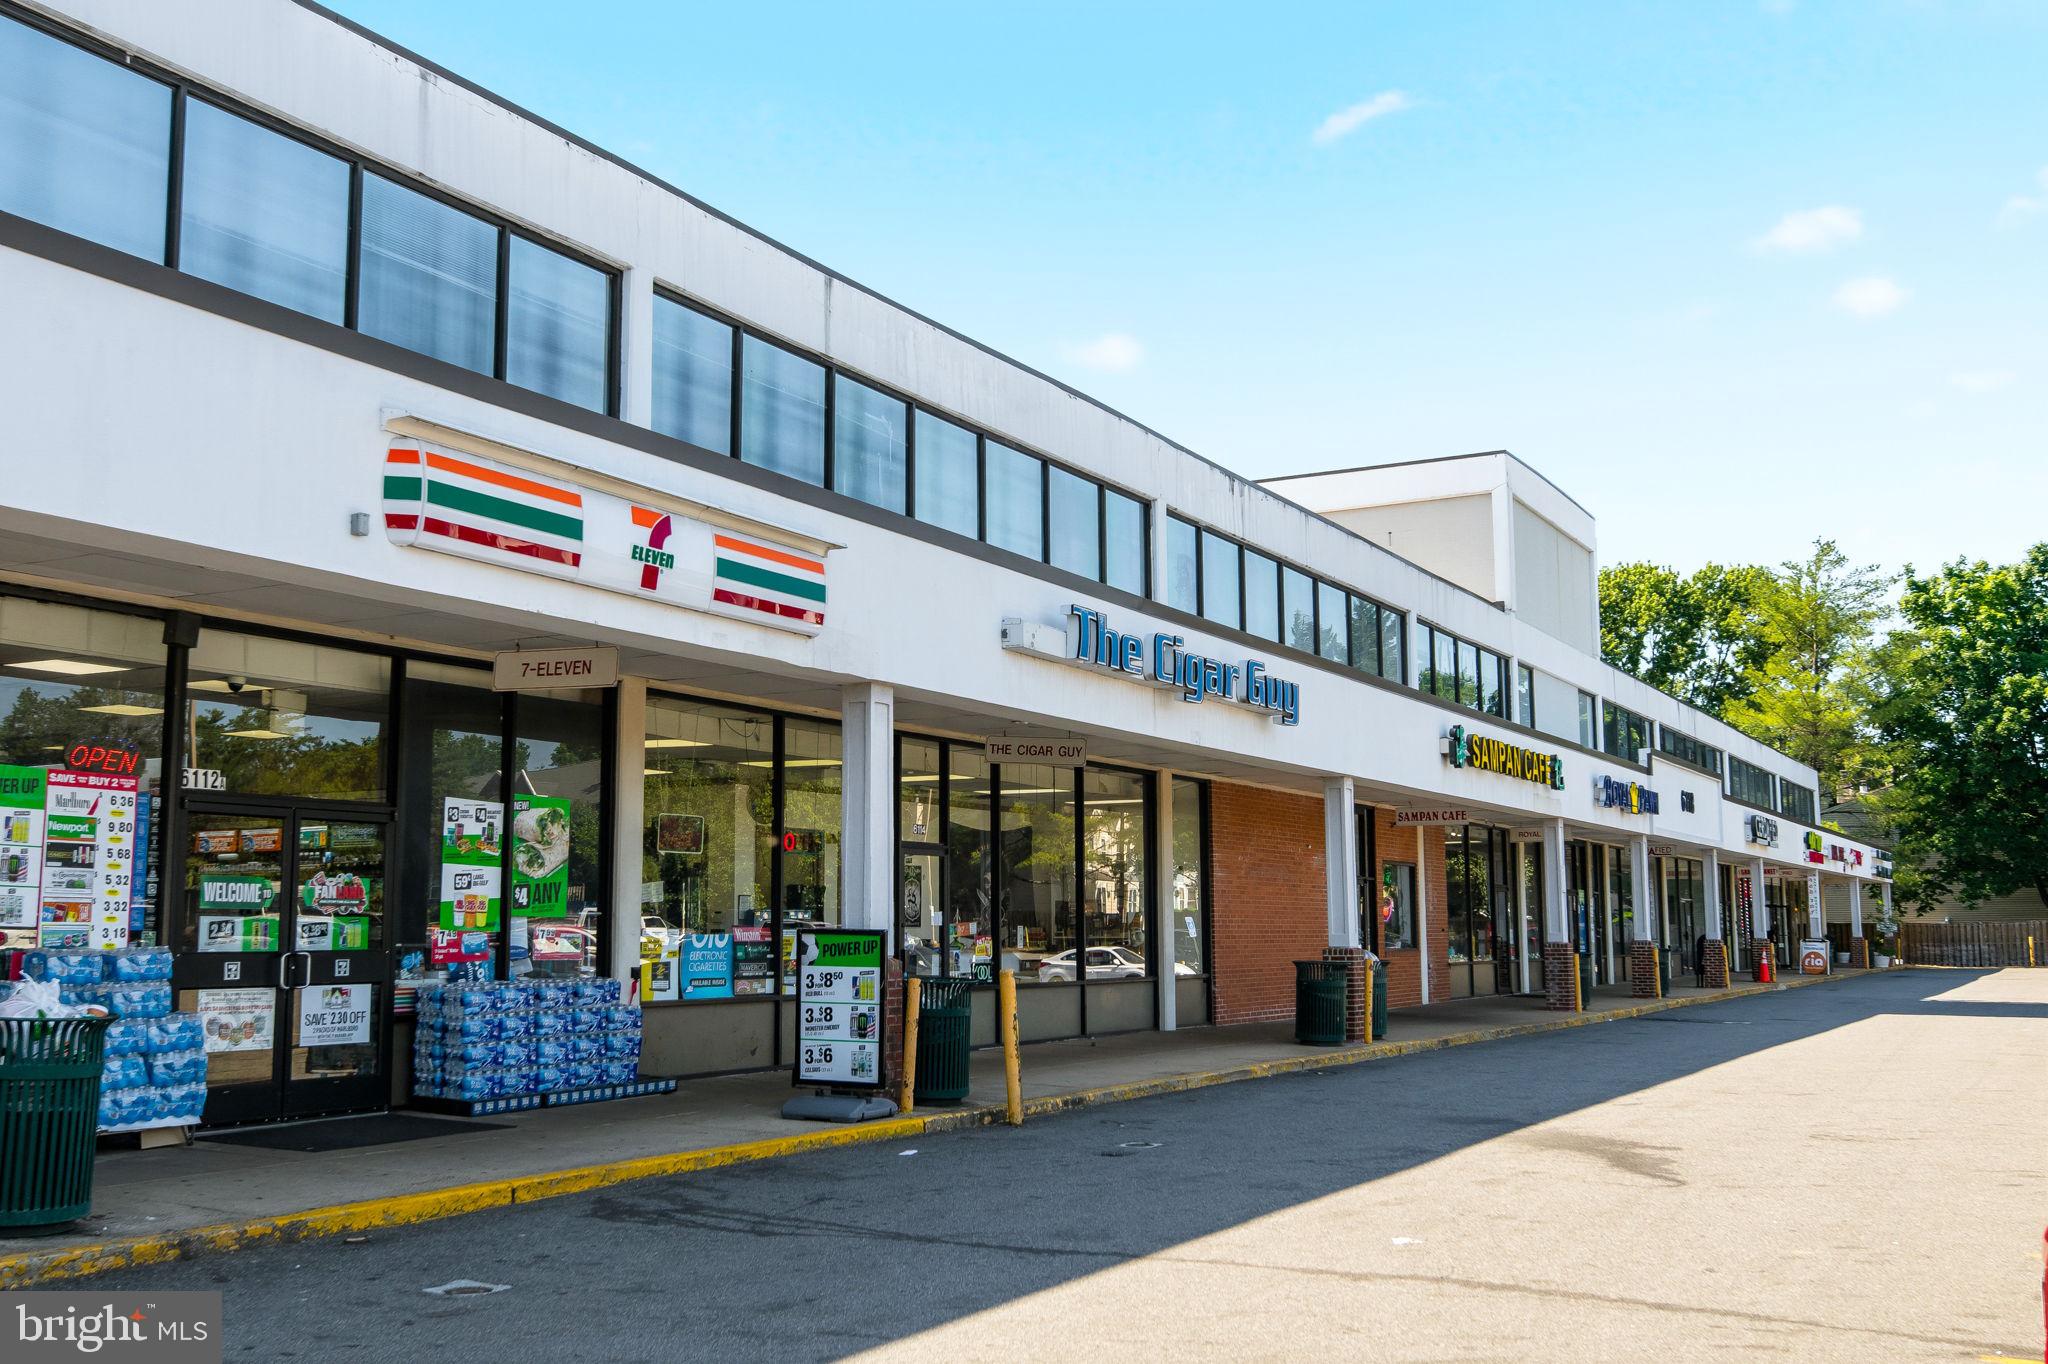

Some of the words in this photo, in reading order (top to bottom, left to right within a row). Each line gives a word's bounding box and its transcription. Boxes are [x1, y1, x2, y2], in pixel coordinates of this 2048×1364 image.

[631, 544, 674, 569] ELEVEN
[521, 660, 592, 677] 7-ELEVEN
[1071, 603, 1144, 675] The
[1153, 631, 1240, 704] Cigar
[1246, 658, 1300, 726] Guy
[989, 743, 1012, 755] THE
[1017, 744, 1053, 757] CIGAR
[1058, 745, 1083, 758] GUY
[69, 745, 140, 774] OPEN
[1471, 733, 1522, 778] SAMPAN
[1523, 748, 1551, 785] CAFE
[21, 778, 39, 793] UP
[49, 773, 76, 783] SAVE
[88, 776, 109, 786] BUY
[513, 801, 529, 810] NEW!
[1398, 811, 1439, 822] SAMPAN
[1441, 811, 1467, 821] CAFE
[48, 820, 89, 834] Newport
[203, 882, 262, 903] WELCOME
[514, 886, 528, 906] $4
[531, 881, 561, 904] ANY
[734, 928, 760, 941] Winston
[690, 950, 728, 961] ELECTRONIC
[822, 942, 861, 958] POWER
[863, 940, 878, 954] UP
[689, 961, 727, 972] CIGARETTES
[806, 973, 815, 989] 3
[304, 1013, 327, 1027] SAVE
[349, 1010, 367, 1024] OFF
[805, 1008, 814, 1023] 3
[805, 1048, 814, 1064] 3
